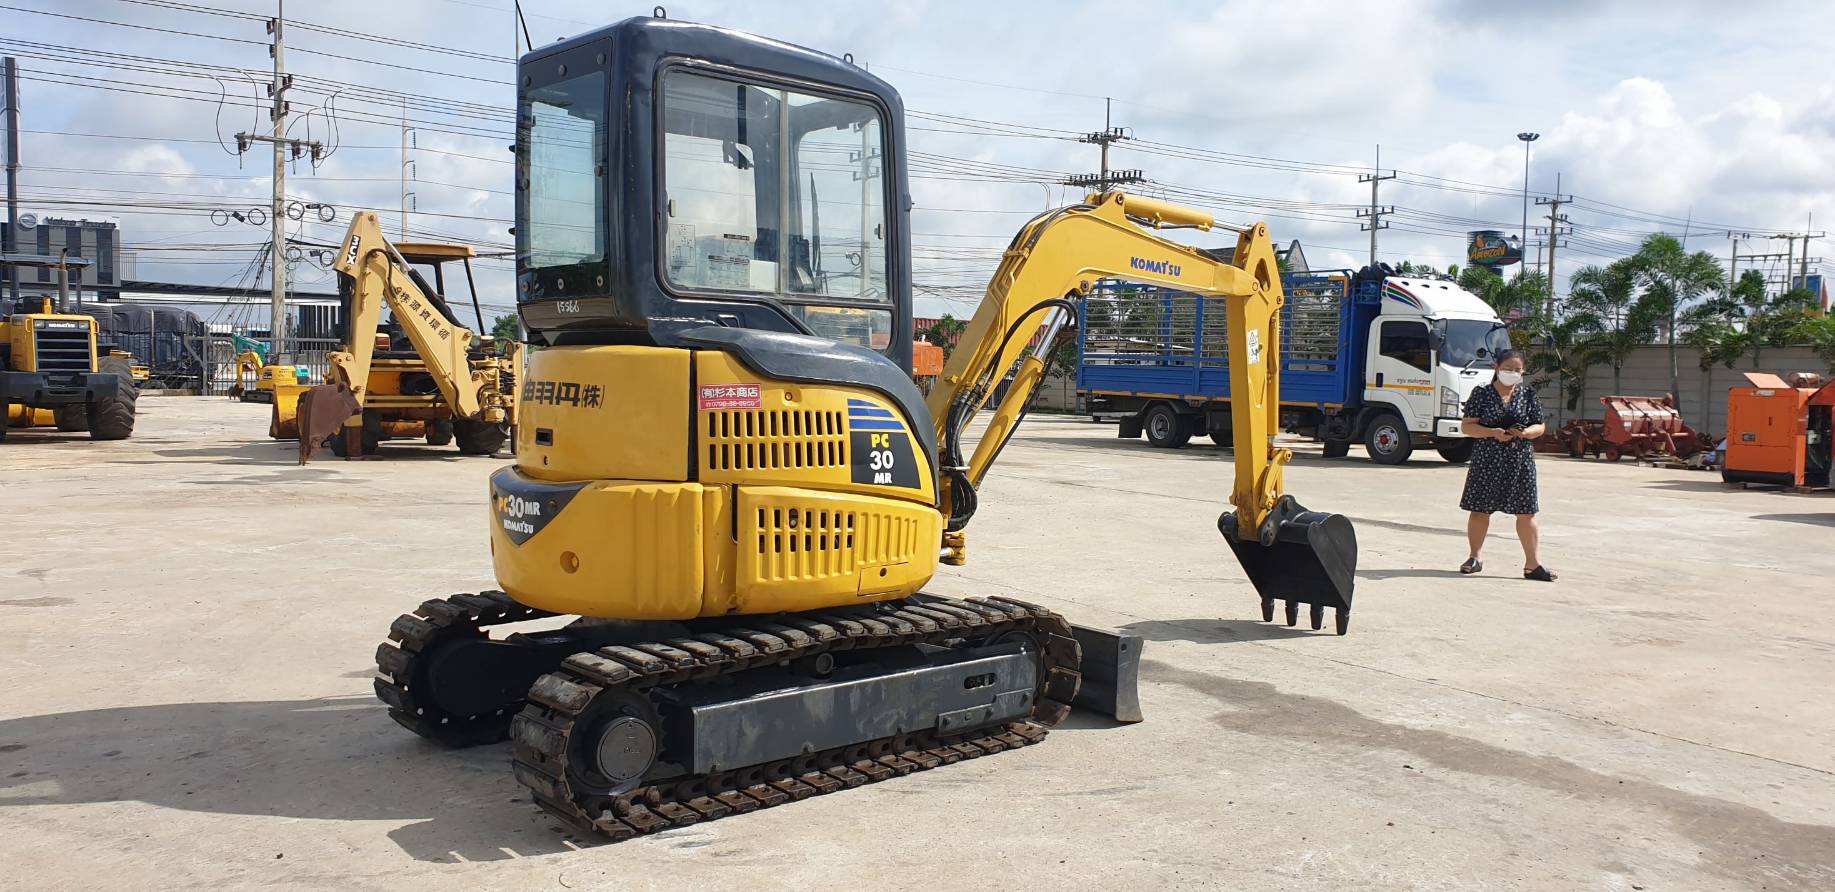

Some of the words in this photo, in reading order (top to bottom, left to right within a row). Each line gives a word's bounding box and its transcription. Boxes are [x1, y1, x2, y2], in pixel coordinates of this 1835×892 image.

[346, 235, 360, 264] 3CX
[1130, 257, 1181, 276] KOMATSU
[871, 433, 890, 448] PC
[870, 450, 894, 470] 30
[874, 472, 892, 484] MR
[503, 519, 534, 534] KOMATSU
